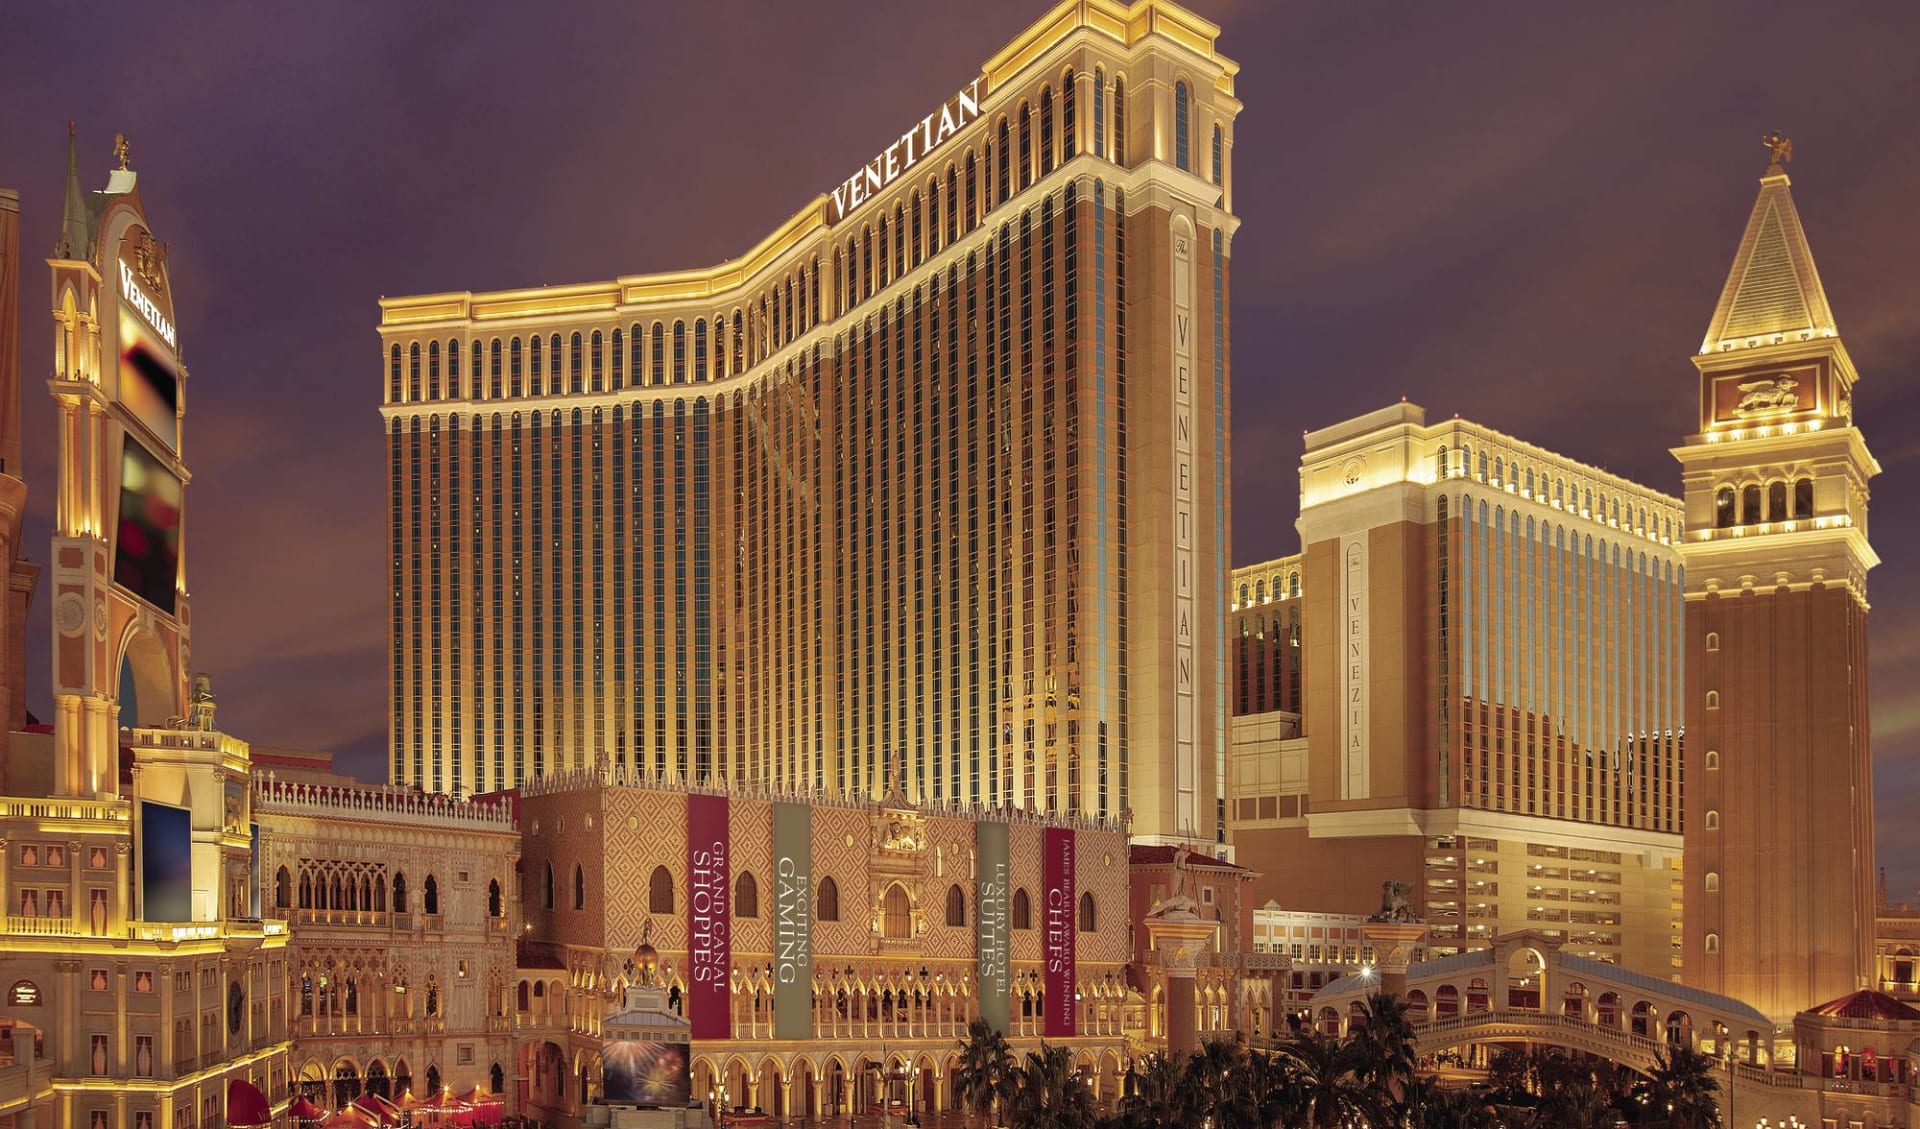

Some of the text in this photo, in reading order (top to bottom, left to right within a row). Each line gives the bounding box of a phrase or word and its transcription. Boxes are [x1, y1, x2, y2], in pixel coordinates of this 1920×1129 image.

[831, 78, 980, 219] VENETIAN
[118, 258, 175, 347] VENETIAN
[1176, 314, 1190, 685] VENETIAN
[1351, 597, 1360, 748] VENEZIA
[693, 850, 711, 981] SHOPPES
[712, 841, 725, 993] GRAND CANAL
[778, 857, 796, 984] GAMING
[796, 875, 808, 967] EXCITING
[981, 882, 996, 977] SUITES
[996, 863, 1006, 997] LUXURY HOTEL
[1049, 888, 1063, 973] CHEFS
[1062, 838, 1071, 1026] JAMES BEARD AWARD WINNING
